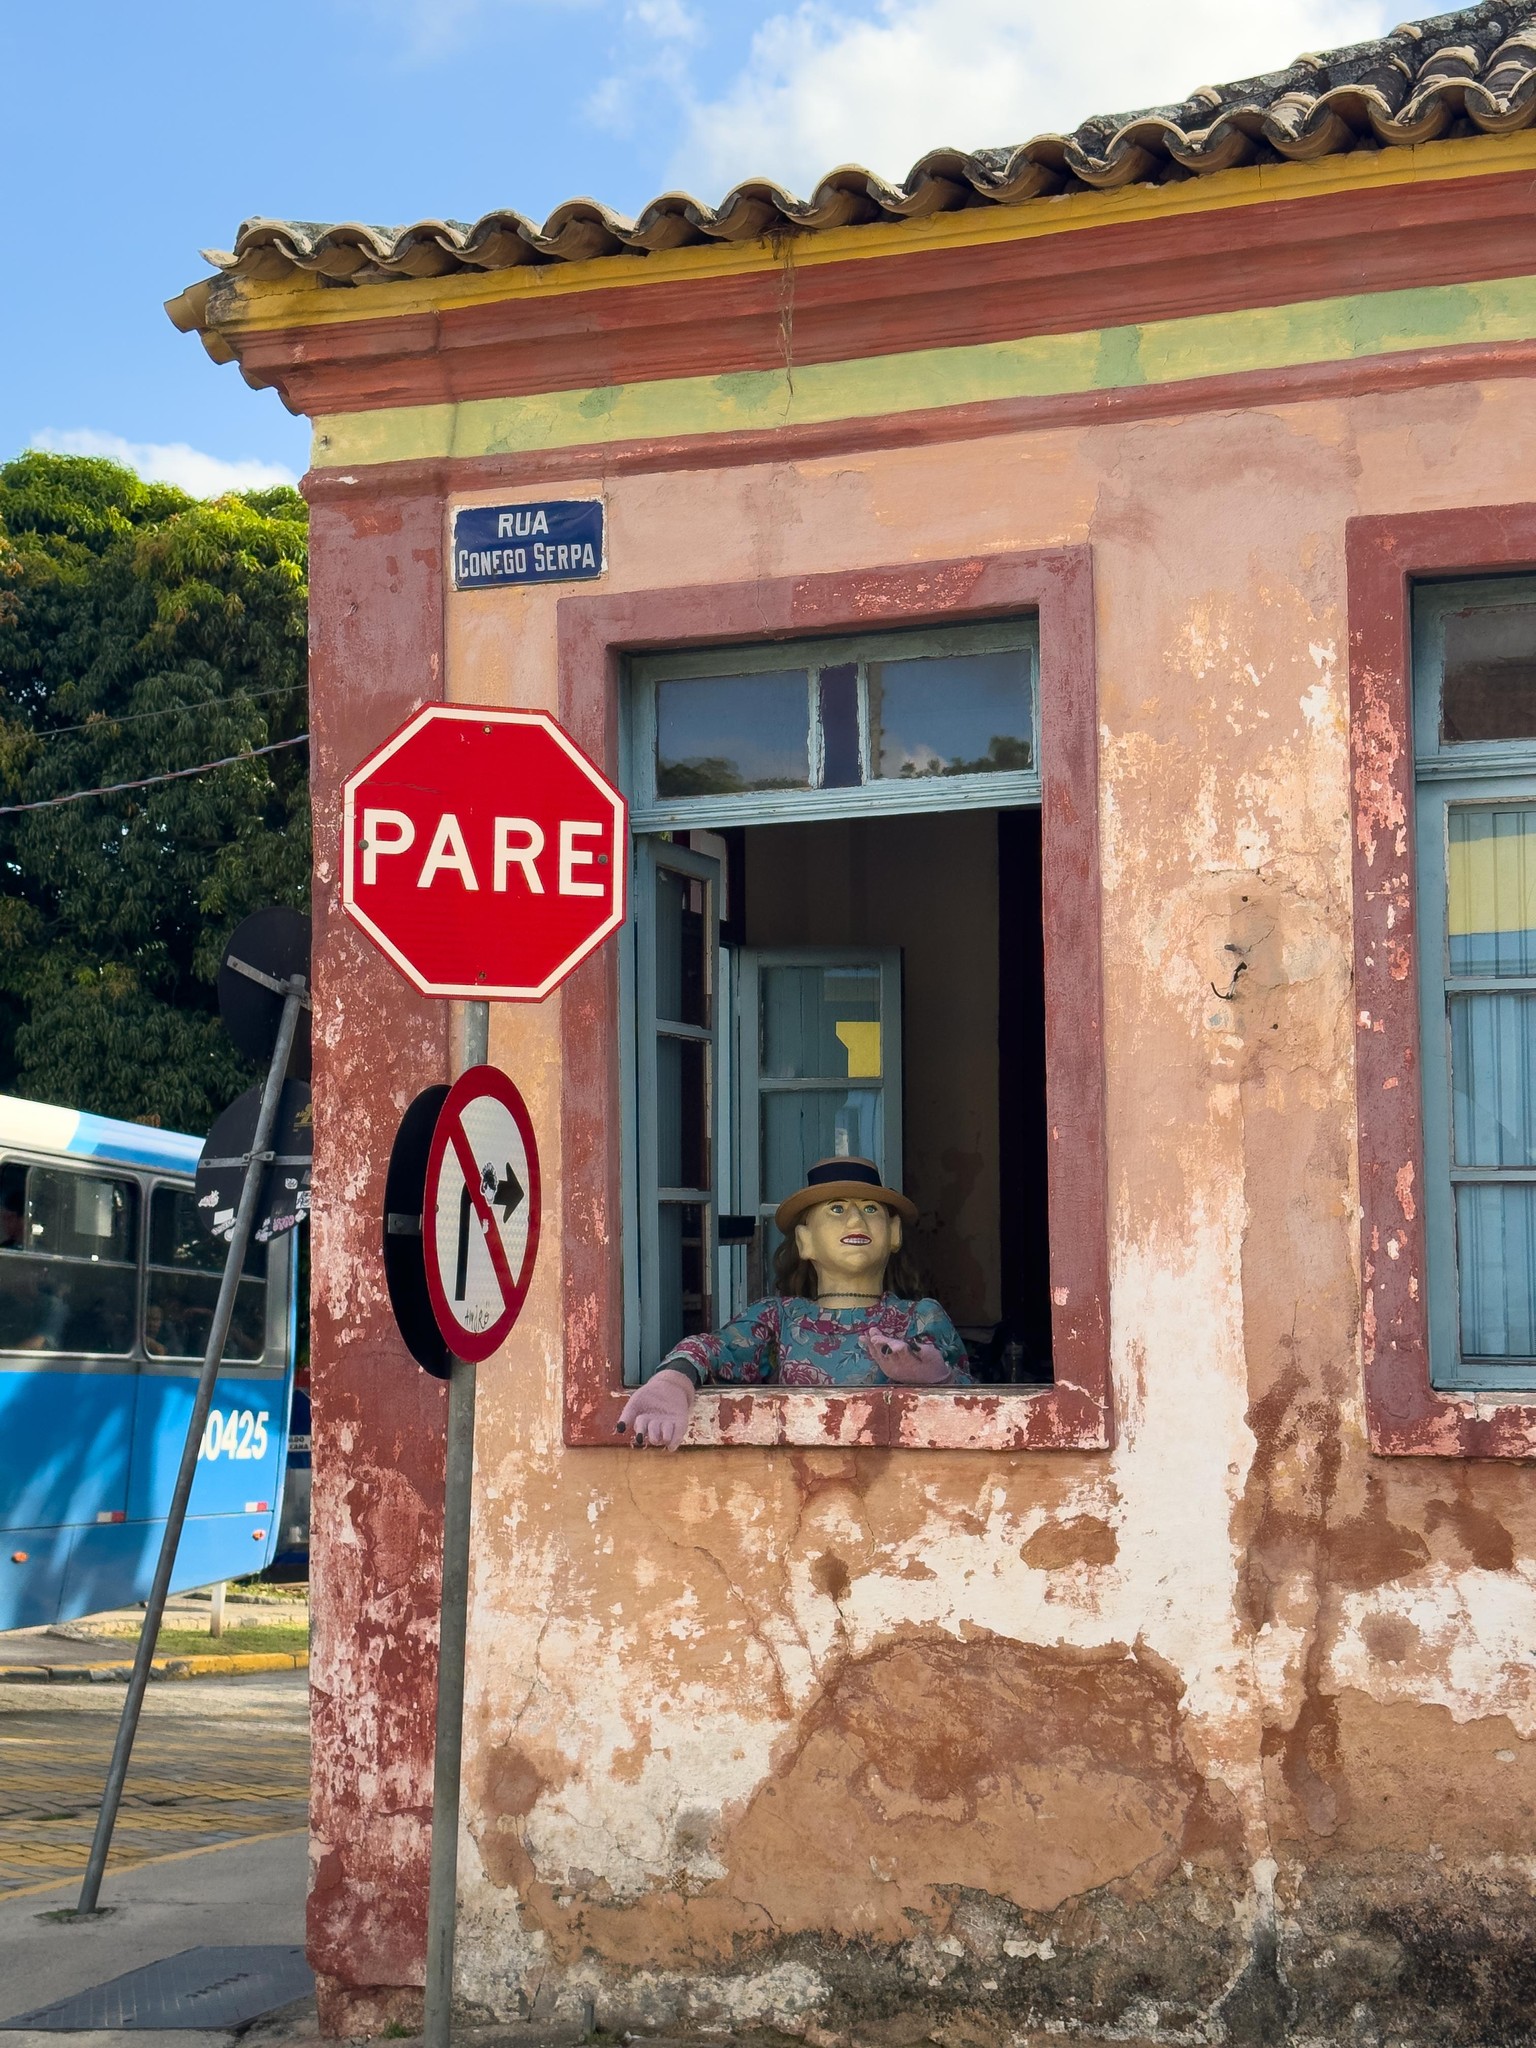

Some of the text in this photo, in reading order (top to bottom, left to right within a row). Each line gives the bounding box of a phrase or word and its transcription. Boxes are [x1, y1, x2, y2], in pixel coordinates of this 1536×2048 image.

[498, 510, 549, 538] RUA
[458, 542, 596, 578] CONEGO SERPA
[362, 808, 605, 897] PARE
[197, 1409, 270, 1462] 0425
